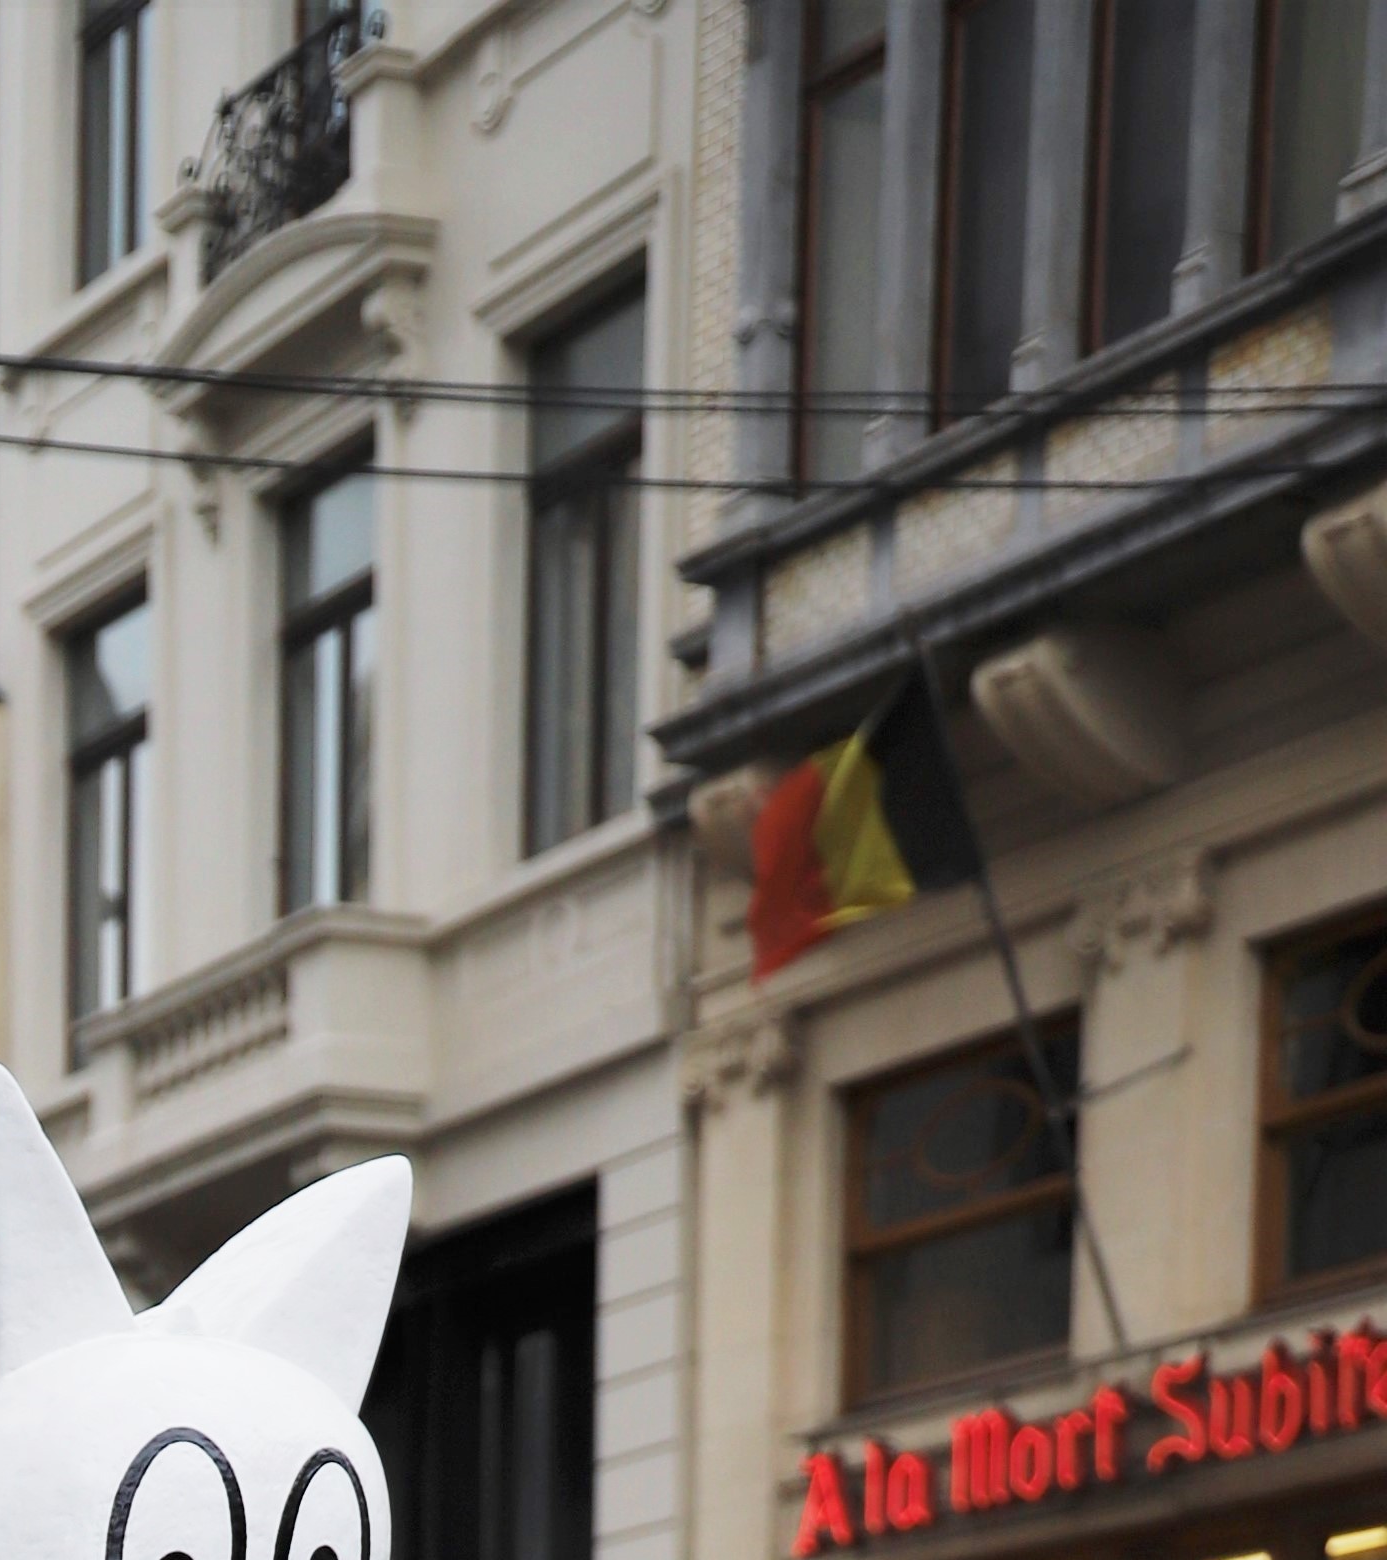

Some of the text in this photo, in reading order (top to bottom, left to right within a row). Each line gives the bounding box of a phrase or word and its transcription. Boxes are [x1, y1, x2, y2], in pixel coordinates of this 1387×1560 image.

[792, 1451, 853, 1558] A
[863, 1440, 933, 1534] la
[949, 1384, 1127, 1512] Mort
